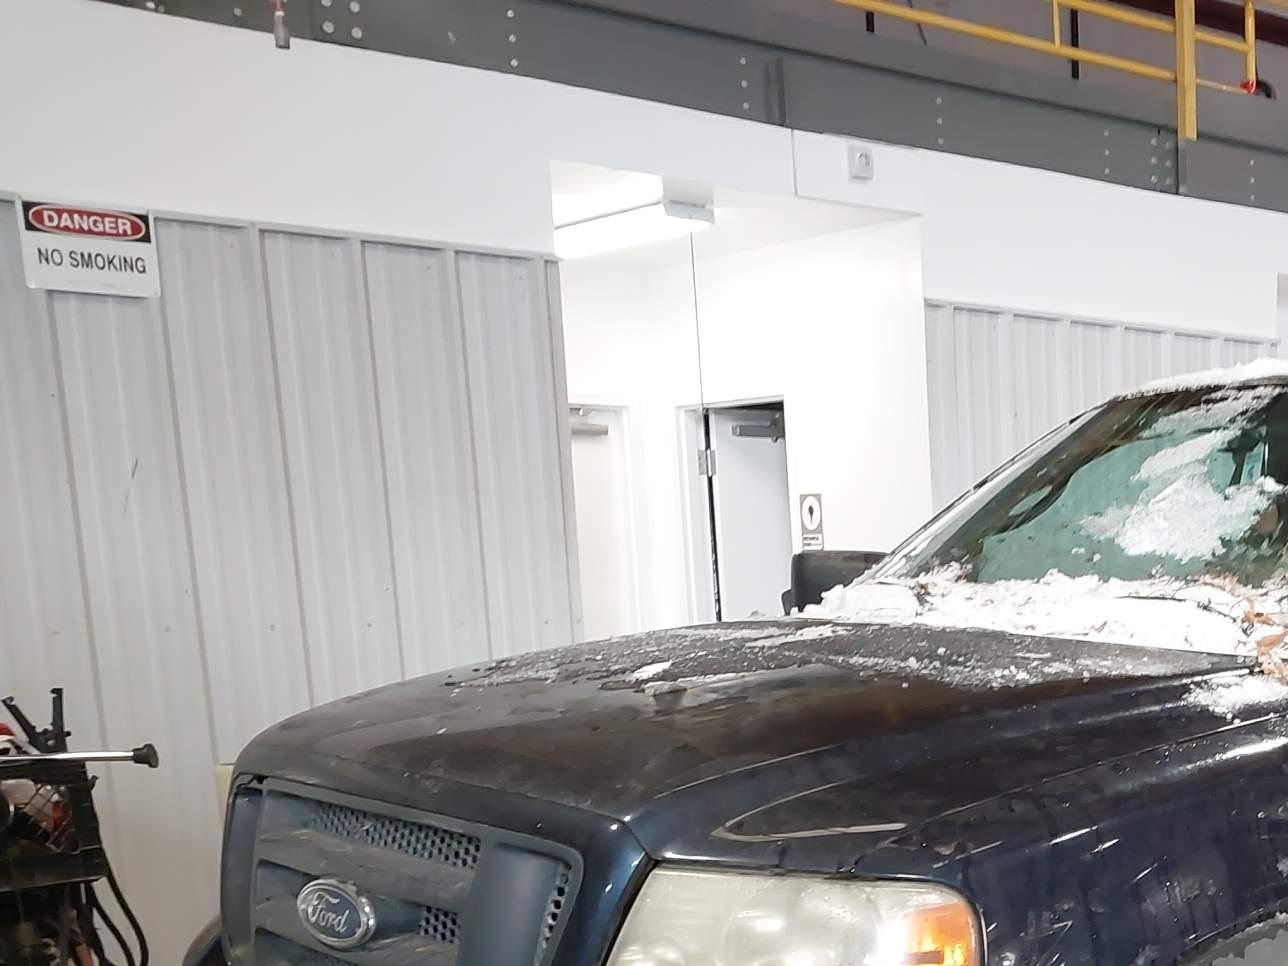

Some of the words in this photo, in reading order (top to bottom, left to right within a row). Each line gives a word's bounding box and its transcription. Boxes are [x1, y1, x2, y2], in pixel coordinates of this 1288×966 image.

[42, 209, 133, 236] DANGER
[37, 247, 64, 267] NO
[69, 250, 147, 274] SMOKING
[307, 891, 350, 933] Ford
